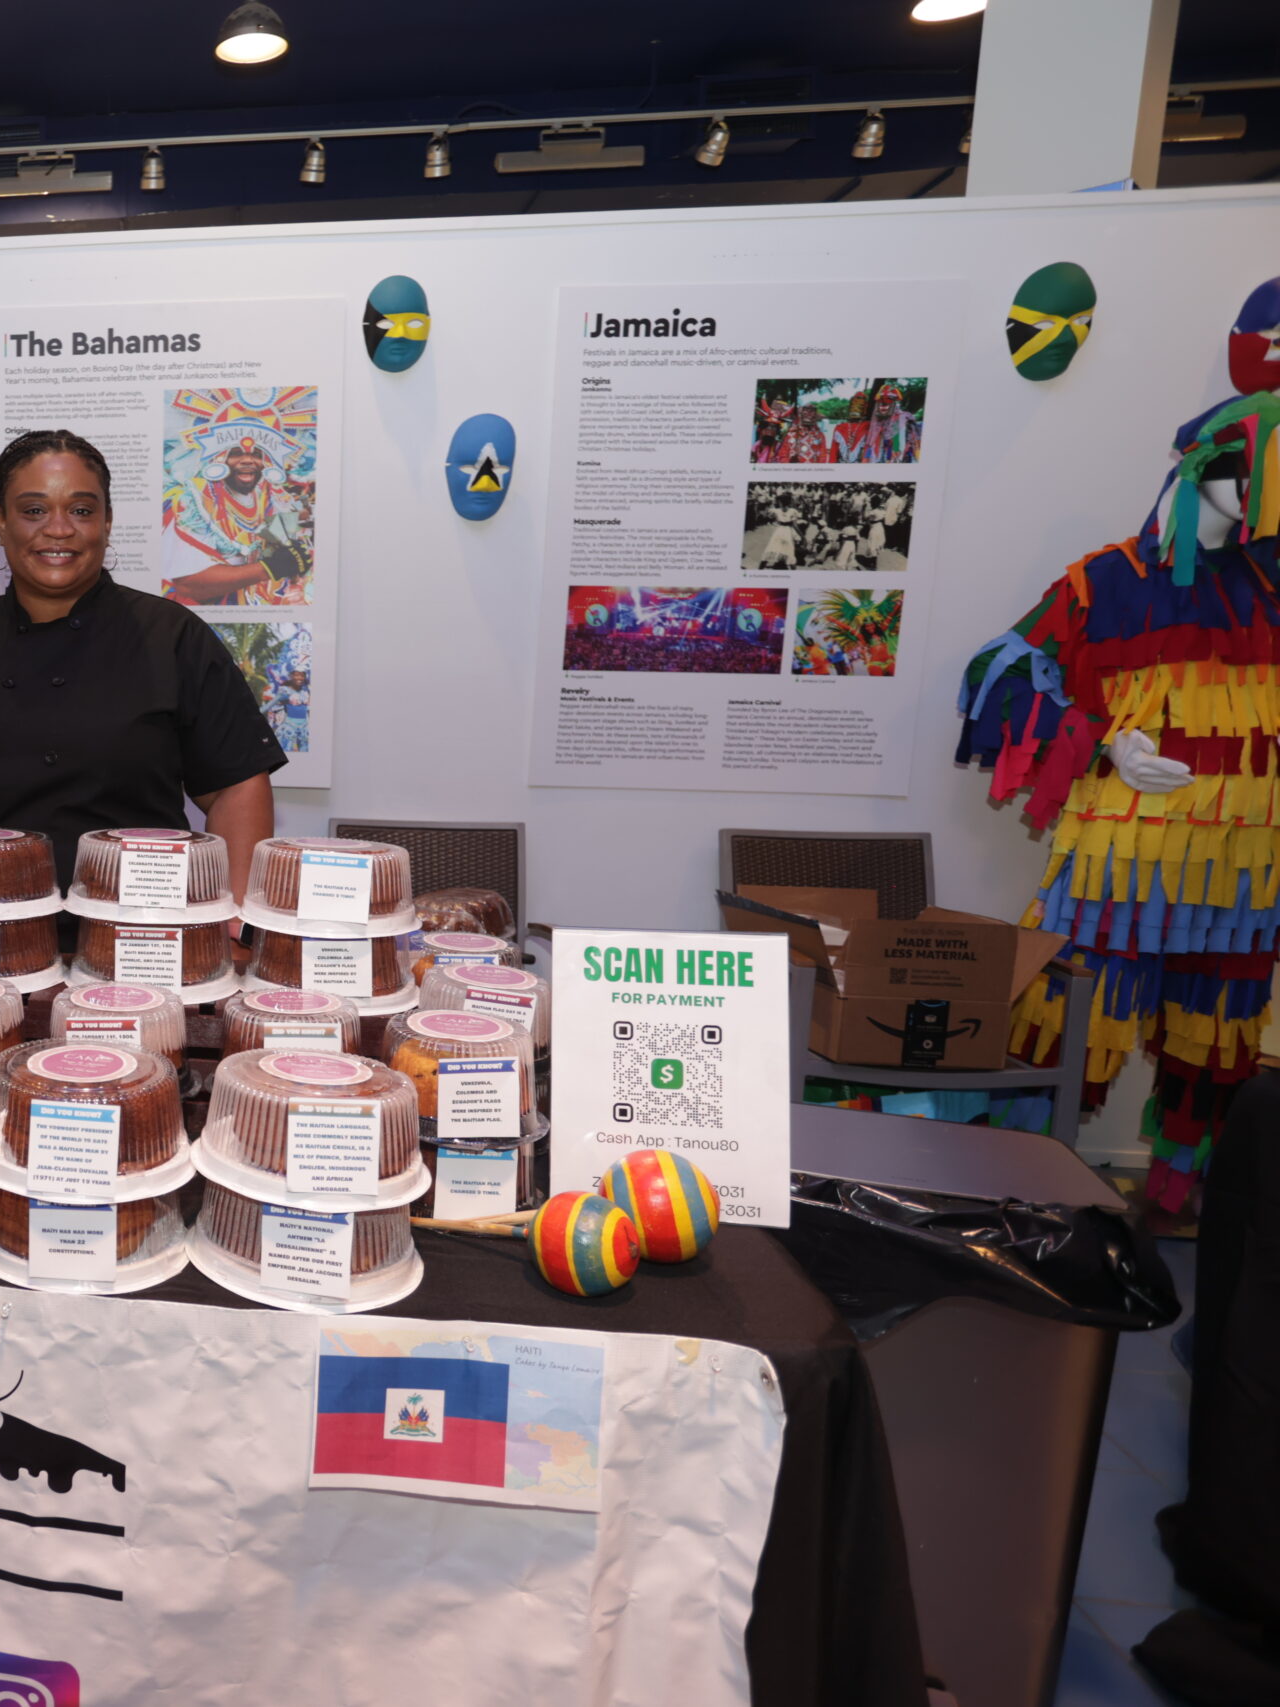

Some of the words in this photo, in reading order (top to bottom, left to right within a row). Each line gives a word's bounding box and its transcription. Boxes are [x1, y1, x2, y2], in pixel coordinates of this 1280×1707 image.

[590, 308, 717, 338] Jamaica
[10, 330, 63, 357] The
[72, 327, 201, 356] Bahamas
[584, 348, 617, 356] Festivals
[698, 348, 708, 356] of
[709, 347, 757, 355] Afro-centric
[760, 346, 790, 354] cultural
[792, 347, 833, 355] traditions,
[24, 366, 49, 375] holiday
[52, 366, 79, 374] season,
[119, 364, 133, 372] Day
[136, 363, 150, 371] (the
[152, 363, 165, 371] day
[168, 362, 185, 370] after
[187, 361, 226, 370] Christmas)
[582, 377, 611, 386] Origins
[216, 428, 277, 451] BAHAMAS
[574, 518, 621, 526] Masquerade
[561, 688, 590, 696] Revelry
[896, 937, 932, 947] MADE
[935, 939, 968, 949] WITH
[884, 948, 912, 958] LESS
[916, 950, 976, 961] MATERIAL
[583, 946, 664, 983] SCAN
[676, 949, 754, 987] HERE
[611, 992, 643, 1005] FOR
[646, 993, 725, 1008] PAYMENT
[74, 1110, 102, 1118] KNOW?
[299, 1104, 314, 1112] DID
[333, 1106, 362, 1114] KNOW?
[596, 1131, 632, 1145] Cash
[636, 1133, 664, 1148] App
[674, 1136, 739, 1152] Tanou80
[304, 1225, 334, 1233] NATIONAL
[515, 1344, 542, 1356] HAITI
